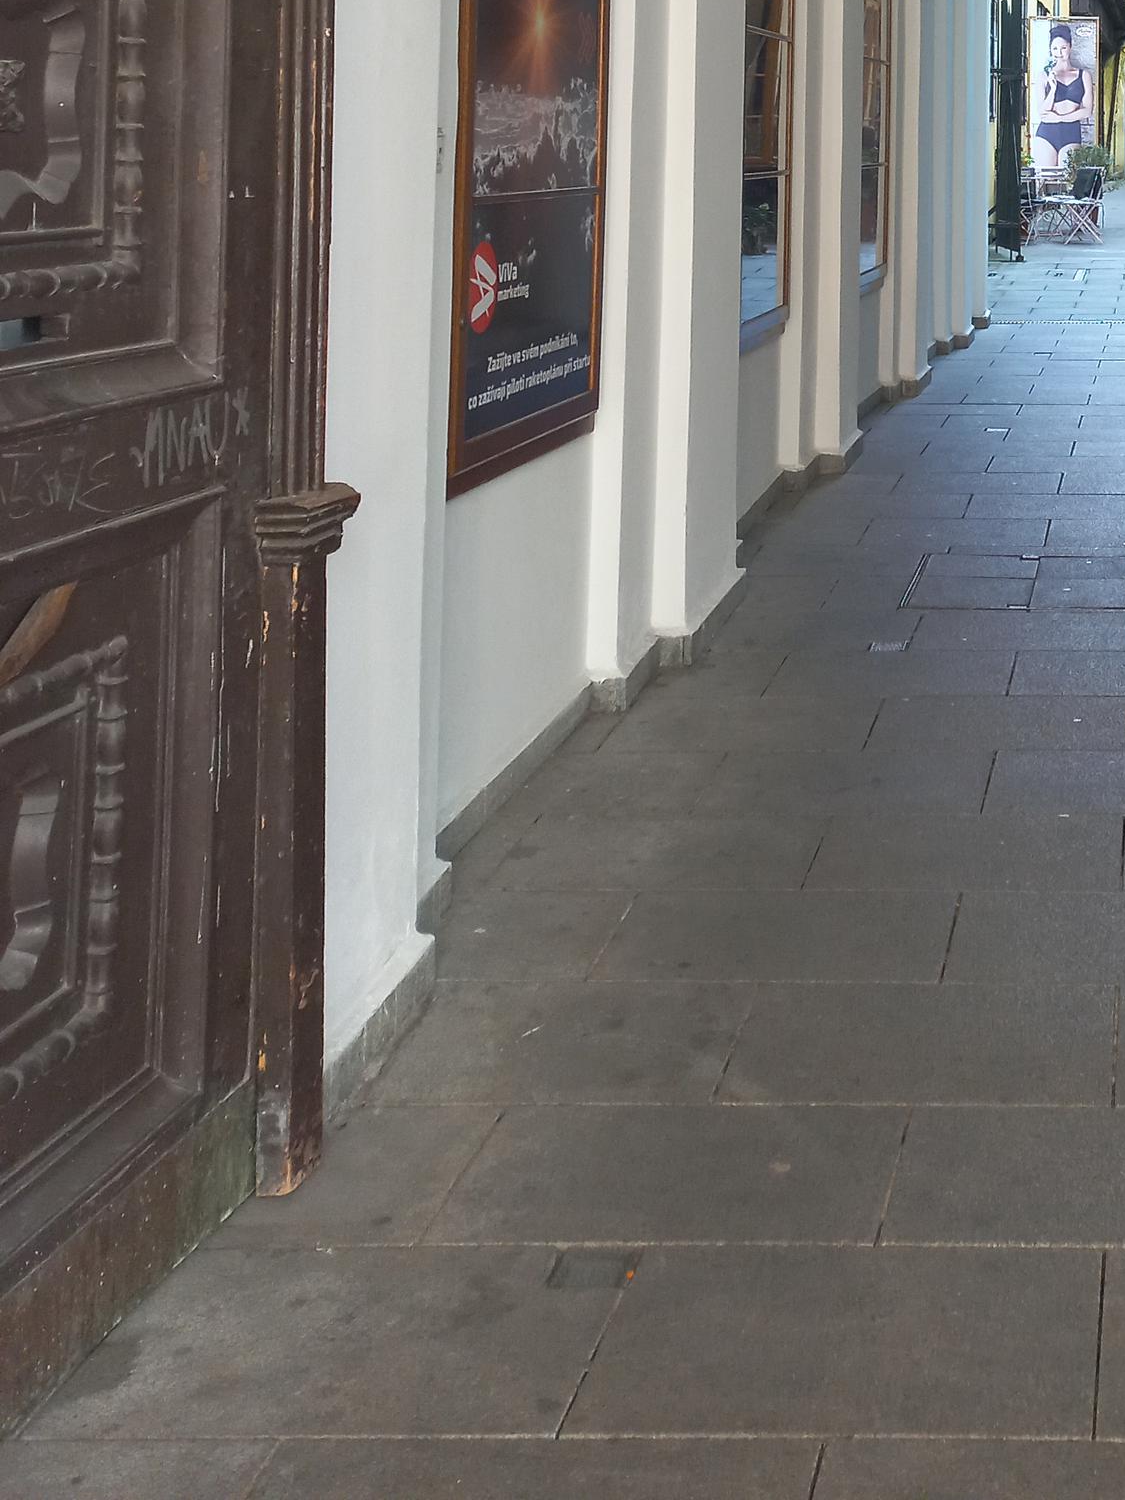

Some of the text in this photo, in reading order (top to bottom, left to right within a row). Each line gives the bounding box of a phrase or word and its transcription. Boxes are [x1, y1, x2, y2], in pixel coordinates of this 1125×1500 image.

[497, 282, 530, 301] marketing
[487, 351, 512, 373] Zažijte
[512, 352, 521, 365] ve
[521, 343, 539, 362] svém
[539, 332, 570, 359] podnikání
[467, 394, 478, 410] co
[478, 382, 506, 406] zažívají
[506, 374, 525, 400] piloti
[525, 363, 563, 388] raketoplánu
[563, 357, 573, 378] při
